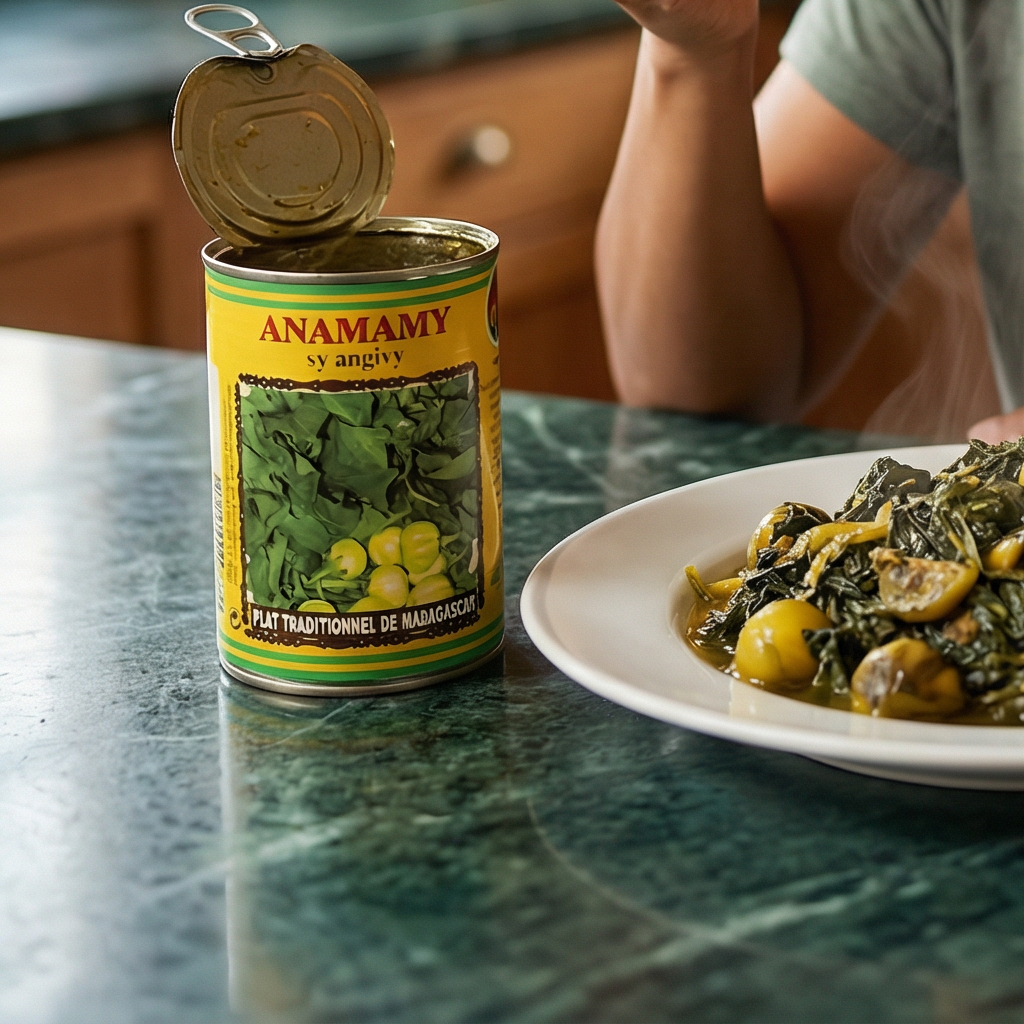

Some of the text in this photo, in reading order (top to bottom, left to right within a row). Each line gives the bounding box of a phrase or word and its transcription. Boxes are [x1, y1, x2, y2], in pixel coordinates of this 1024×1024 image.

[260, 306, 451, 344] ANAMAMY
[307, 347, 404, 372] sy angivy
[253, 595, 476, 636] PLAT TRADITIONNEL DE MADAGASCAR
